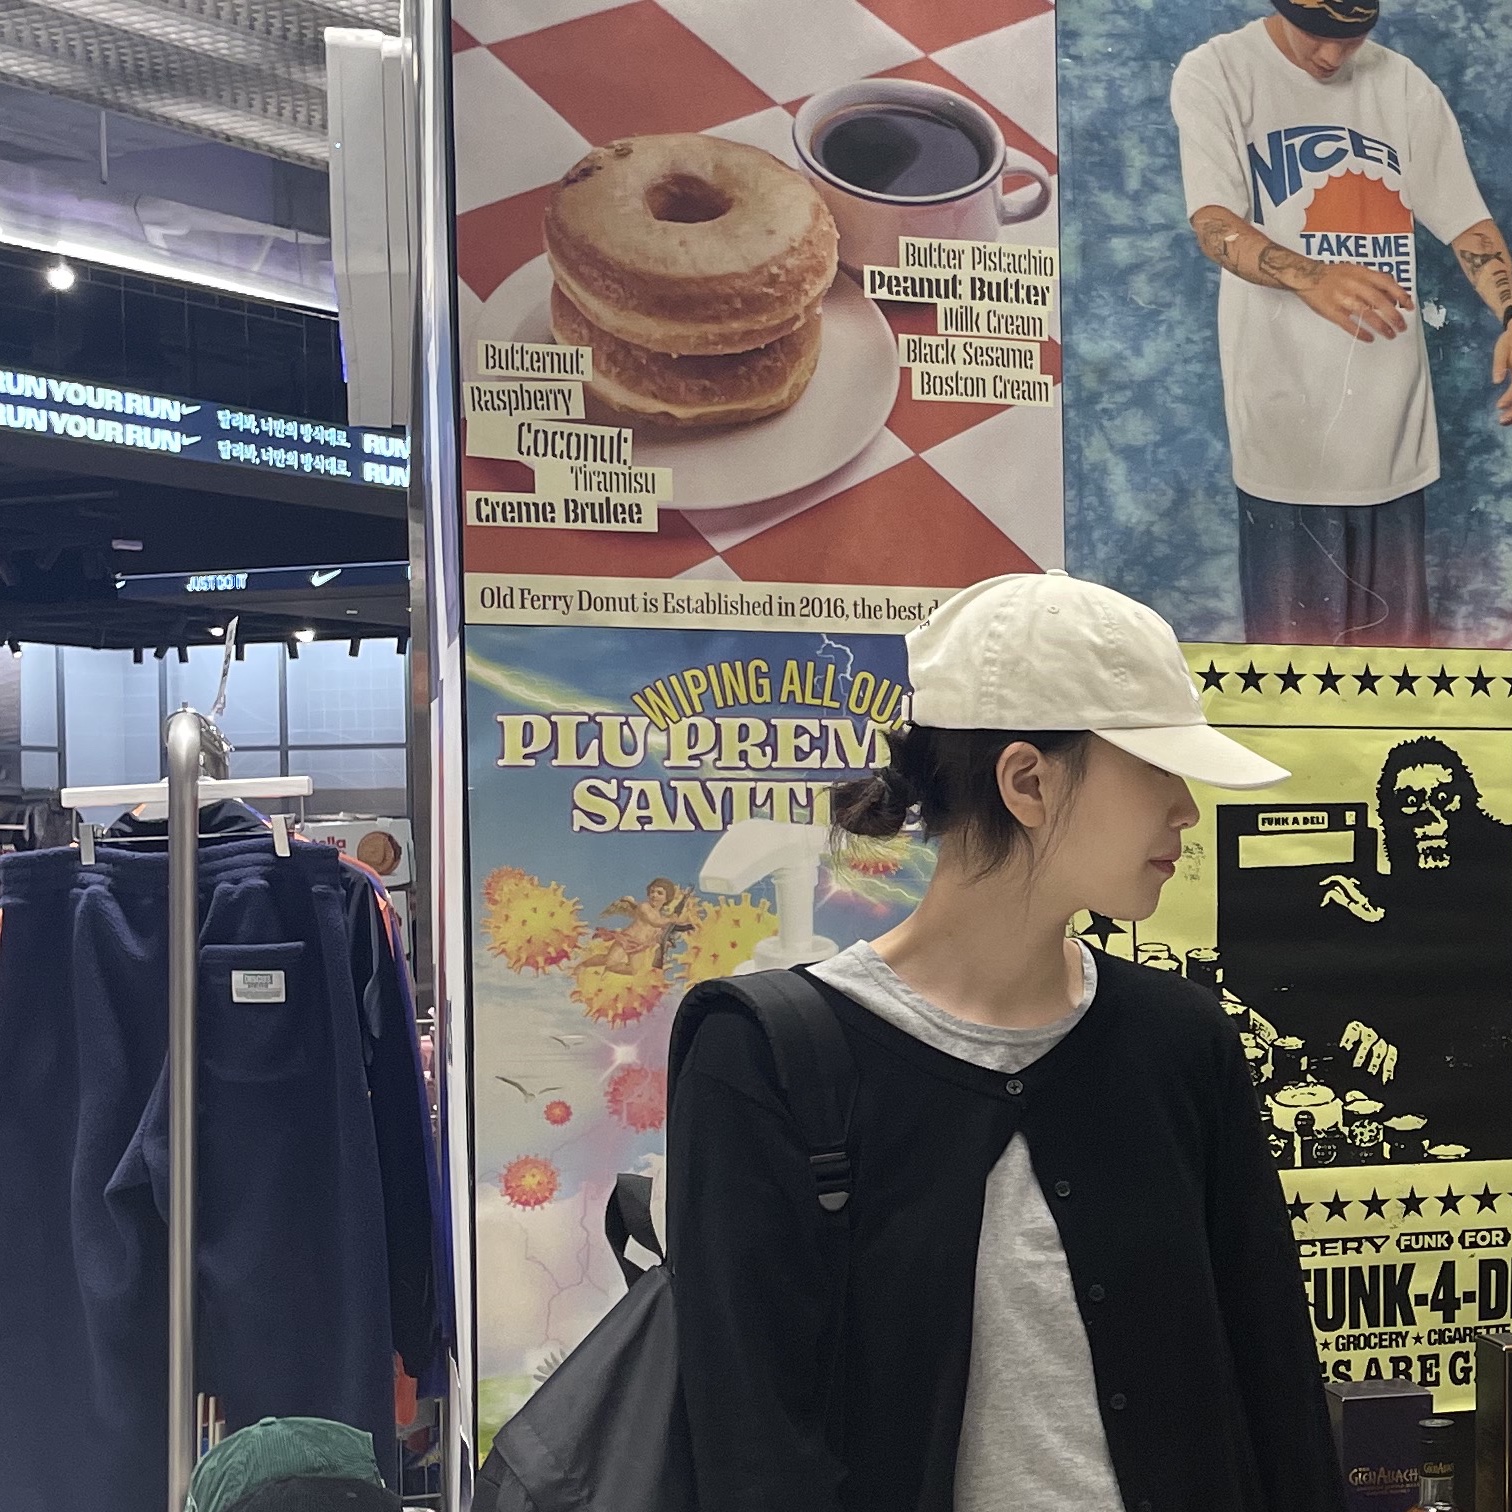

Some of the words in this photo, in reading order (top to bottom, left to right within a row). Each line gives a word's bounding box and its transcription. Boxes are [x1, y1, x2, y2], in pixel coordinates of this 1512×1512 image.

[904, 241, 965, 271] Butter
[971, 244, 1054, 278] Pistachio
[1300, 233, 1369, 259] TAKE
[1372, 235, 1410, 259] ME
[869, 269, 963, 301] Peanut
[970, 275, 1050, 307] Butter
[943, 304, 980, 333] Milk
[986, 309, 1043, 338] Cream
[484, 343, 585, 375] Butternut
[906, 336, 956, 366] Black
[962, 340, 1034, 370] Sesame
[48, 379, 124, 413] YOUR
[124, 392, 182, 422] RUN
[470, 383, 572, 417] Raspberry
[920, 370, 986, 399] Boston
[993, 374, 1049, 403] Cream
[48, 411, 124, 444] YOUR
[124, 423, 182, 453] RUN
[361, 433, 410, 459] RUN
[517, 421, 628, 466] Coconut
[362, 461, 410, 487] RUN
[569, 464, 656, 495] Tiramisu
[475, 497, 556, 525] Creme
[563, 496, 643, 525] Brulee
[480, 585, 514, 610] Old
[518, 587, 574, 615] Ferry
[577, 589, 639, 613] Donut
[642, 591, 658, 614] is
[662, 591, 773, 617] Established
[777, 595, 796, 617] in
[799, 596, 849, 621] 2016,
[852, 596, 882, 620] the
[885, 597, 925, 621] best
[631, 658, 772, 733] WIPING
[780, 659, 841, 709] ALL
[848, 670, 912, 732] OU
[495, 713, 650, 769] PLU
[661, 714, 893, 771] PREM
[572, 776, 836, 833] SANITI
[1261, 816, 1289, 827] FUNK
[1291, 816, 1300, 826] A
[1302, 815, 1325, 826] DELI
[1299, 1235, 1391, 1257] CERY
[1399, 1233, 1449, 1251] FUNK
[1463, 1230, 1505, 1247] FOR
[1334, 1331, 1411, 1353] GROCERY
